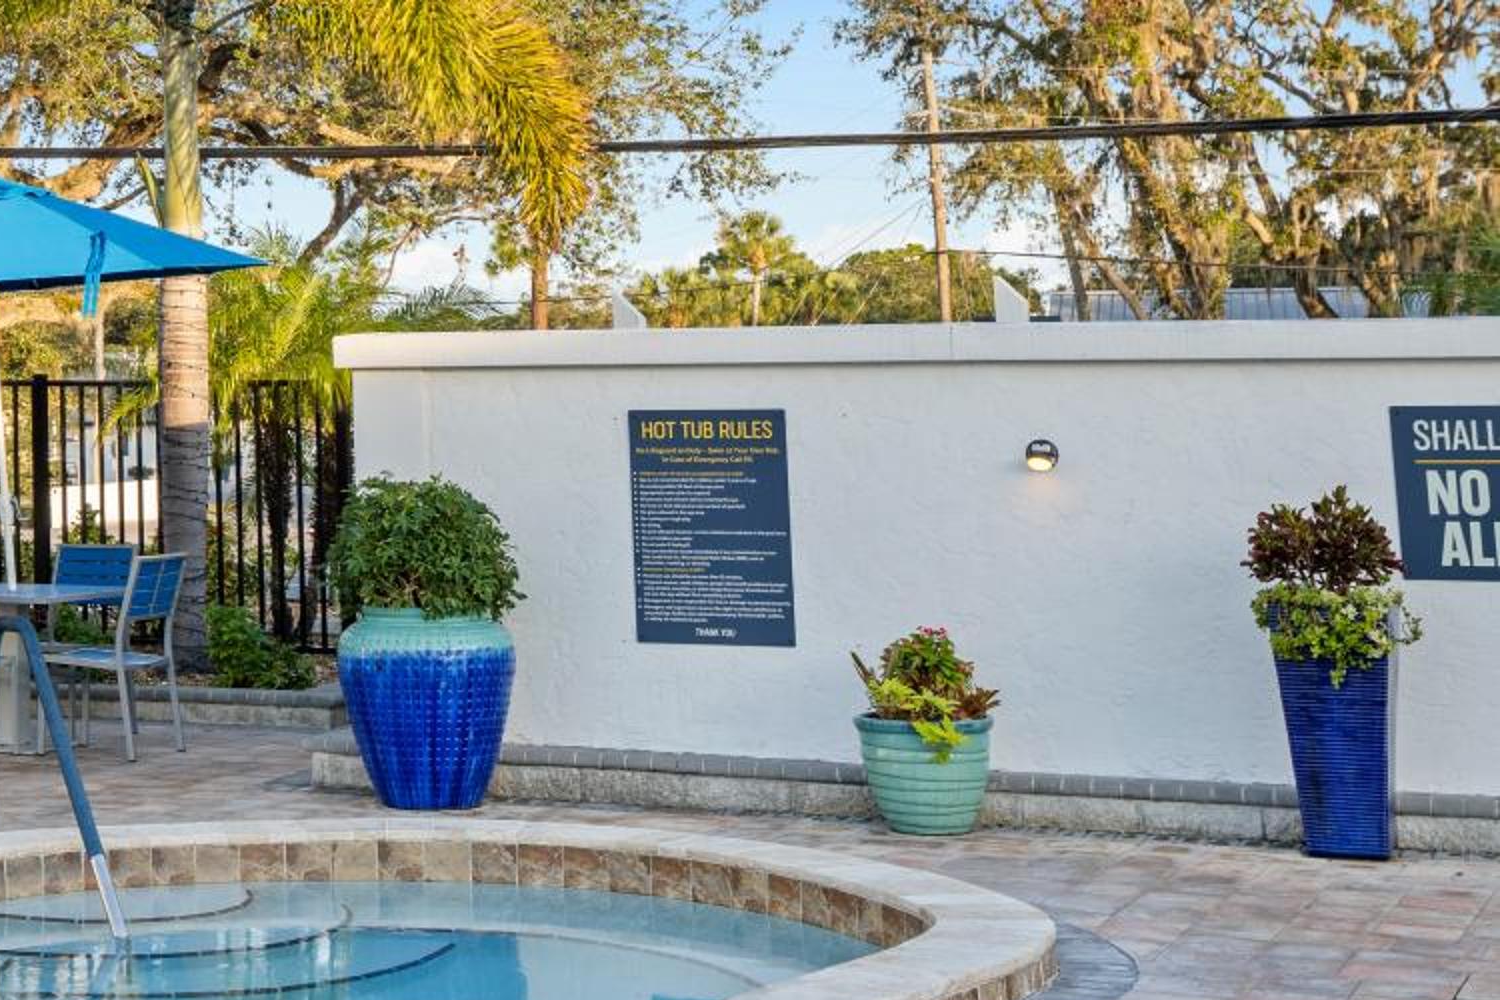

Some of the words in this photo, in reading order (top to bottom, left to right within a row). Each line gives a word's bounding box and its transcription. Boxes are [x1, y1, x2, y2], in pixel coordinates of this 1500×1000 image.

[641, 420, 676, 439] HOT
[680, 420, 714, 439] TUB
[719, 420, 773, 439] RULES
[1412, 419, 1500, 451] SHALL
[1425, 469, 1491, 516] NO
